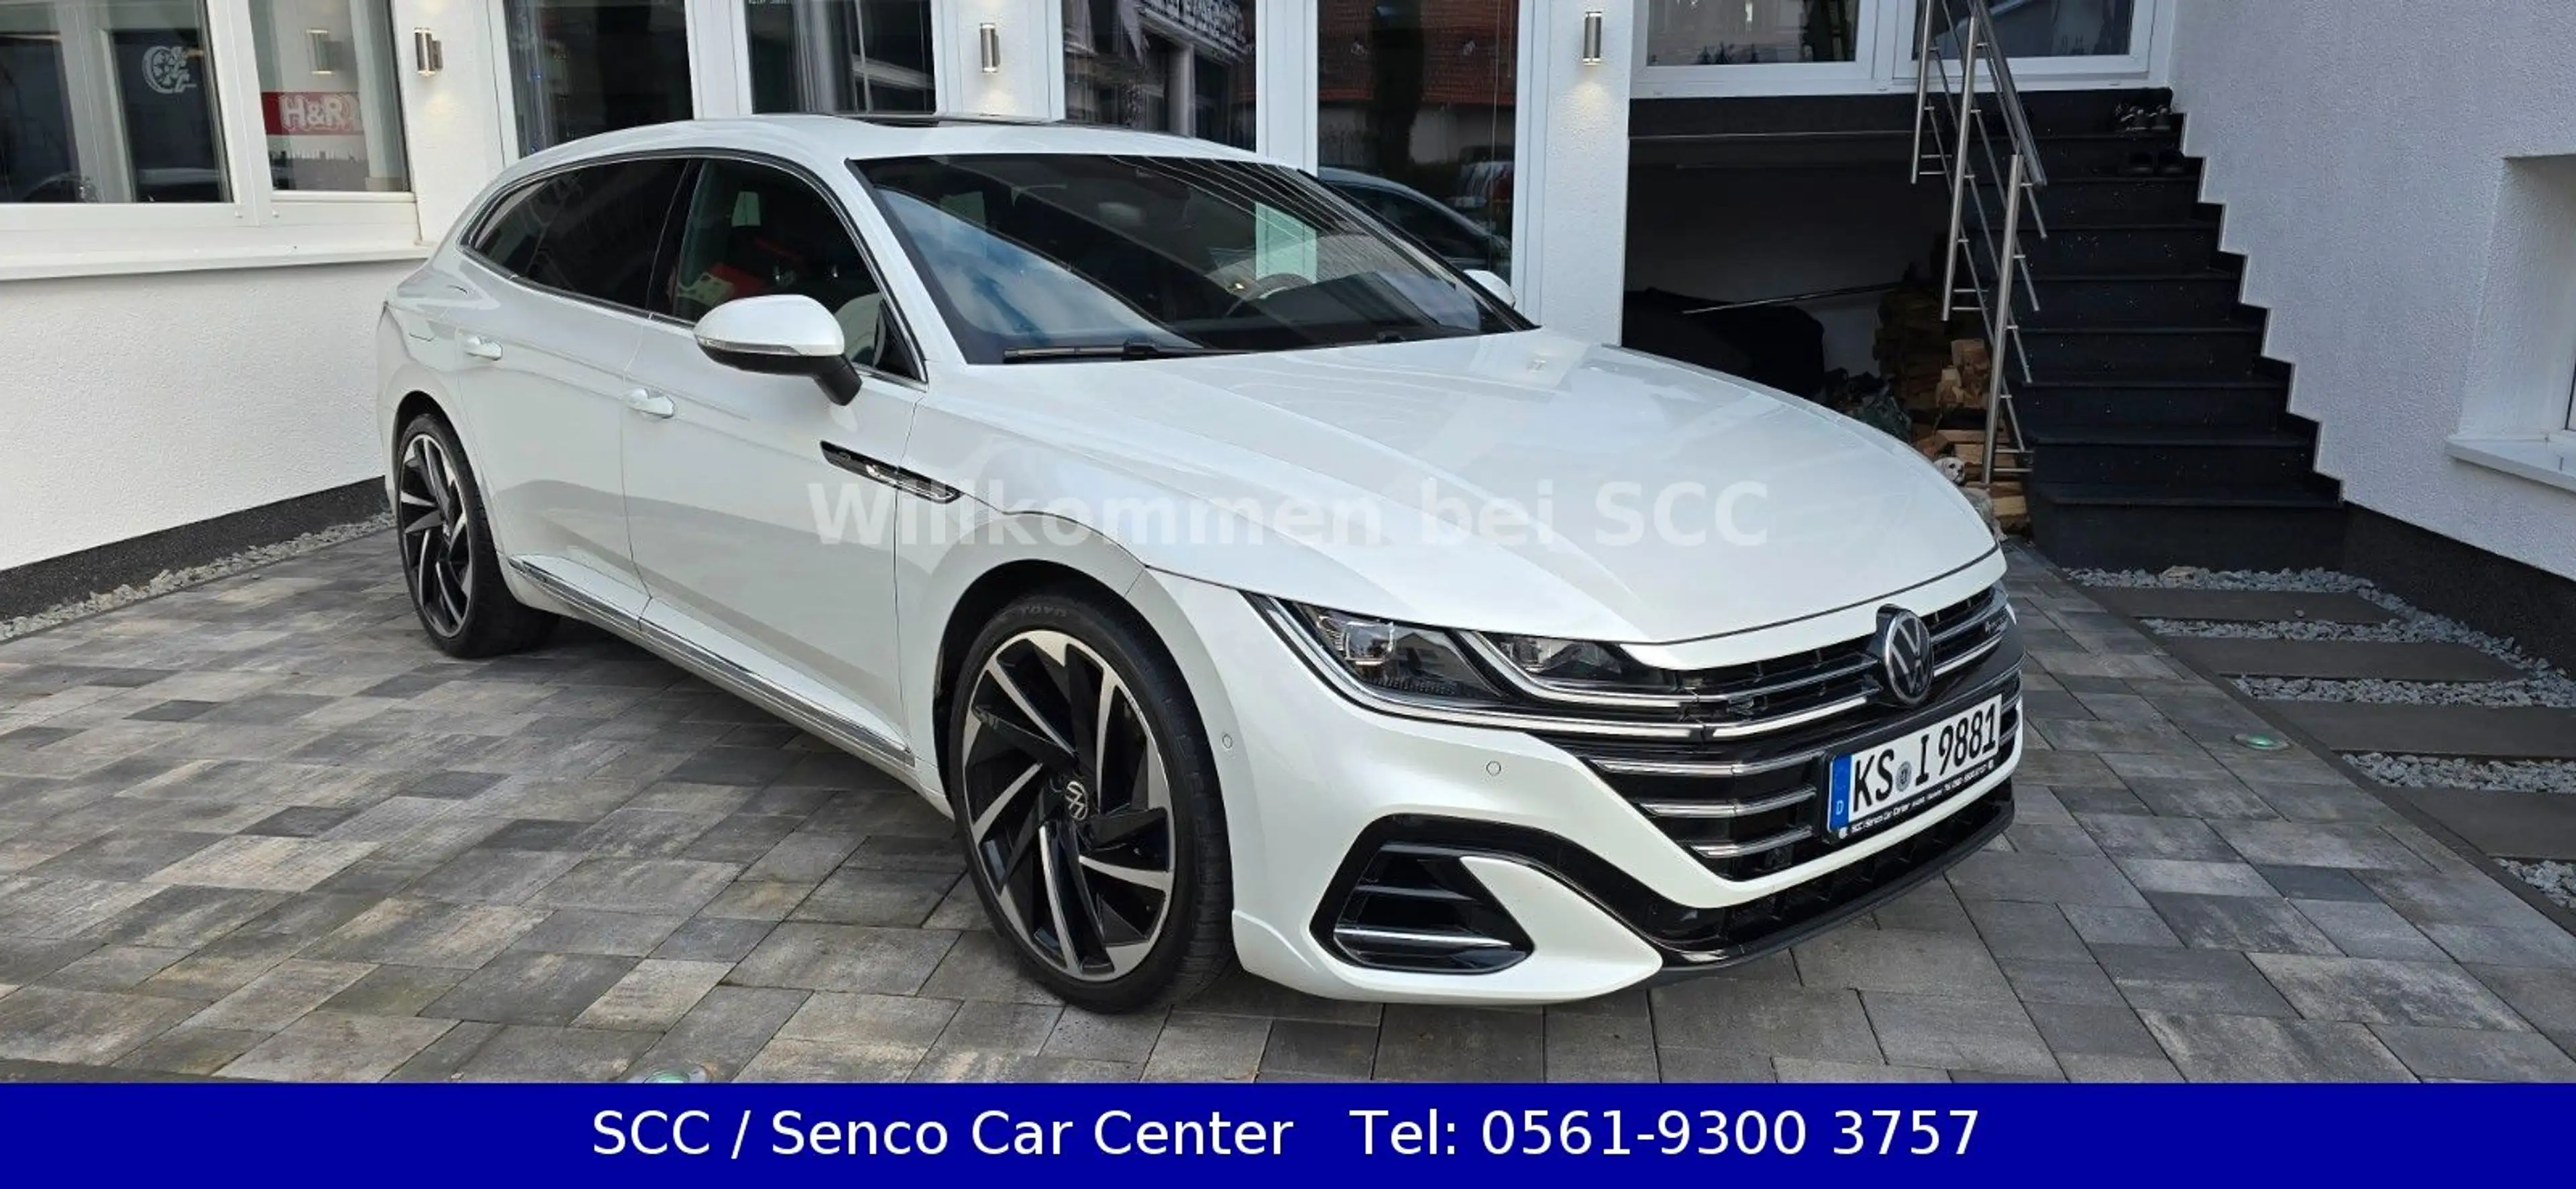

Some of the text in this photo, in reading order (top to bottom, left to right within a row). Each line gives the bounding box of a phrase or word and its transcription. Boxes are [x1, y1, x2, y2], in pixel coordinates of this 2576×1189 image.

[280, 95, 347, 129] H&R
[1853, 748, 1894, 813] KS
[1915, 734, 1929, 786] I
[1939, 703, 1996, 776] 9881
[1835, 799, 1845, 815] D
